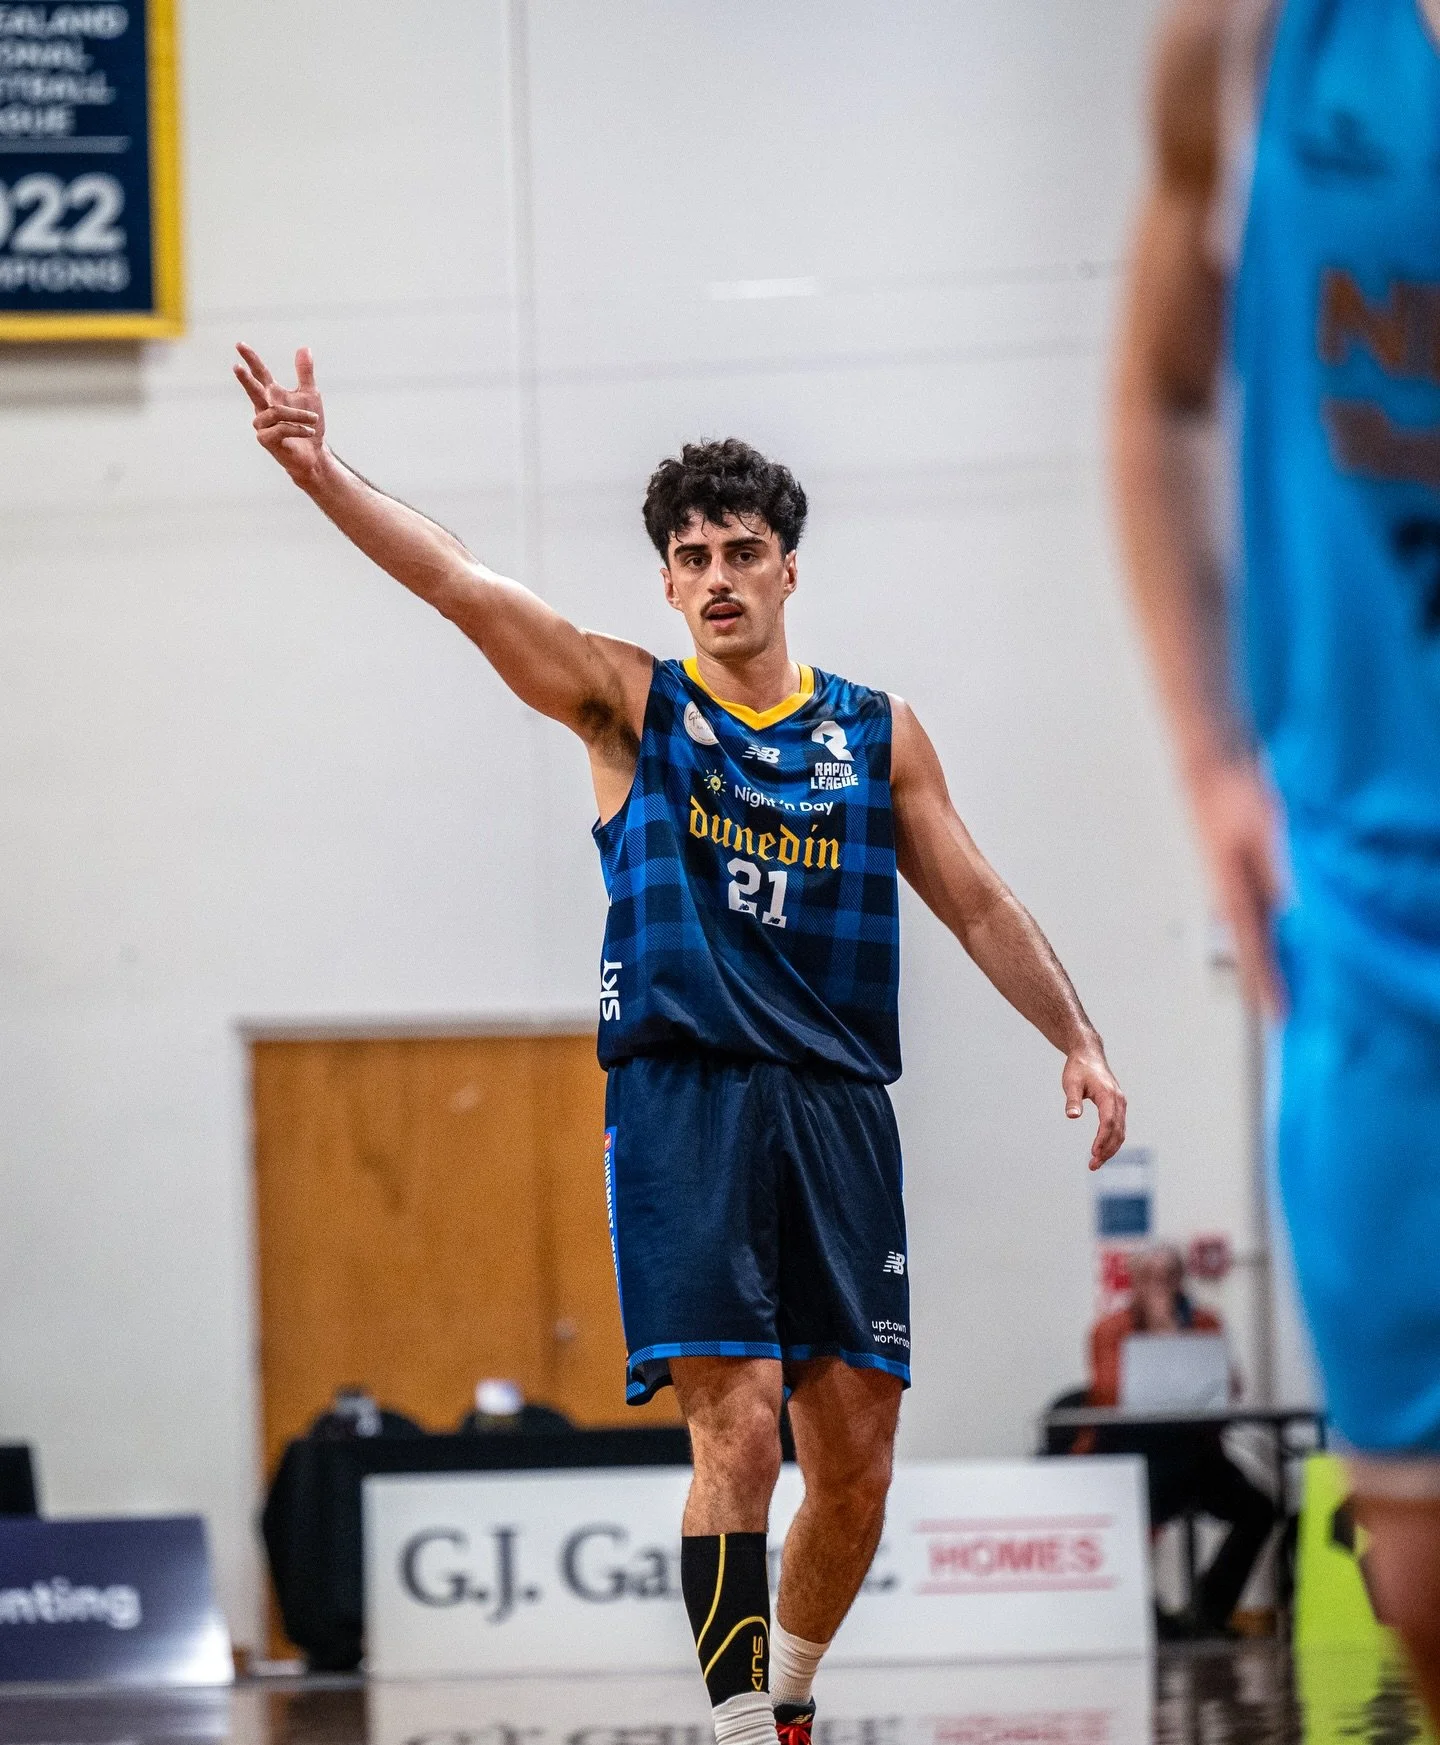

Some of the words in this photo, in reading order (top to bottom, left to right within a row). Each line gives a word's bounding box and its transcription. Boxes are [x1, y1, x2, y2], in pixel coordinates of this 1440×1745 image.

[810, 774, 859, 790] LEAGUE
[815, 762, 853, 777] RAPID
[734, 784, 777, 808] Night
[800, 801, 834, 816] Day
[689, 794, 841, 870] dunedin
[727, 857, 788, 929] 21
[600, 958, 623, 1021] SKY
[871, 1319, 907, 1334] uptown
[873, 1333, 911, 1350] workroo
[398, 1523, 542, 1627] G.J.
[558, 1521, 682, 1605] Ga
[928, 1535, 1104, 1577] HOMES
